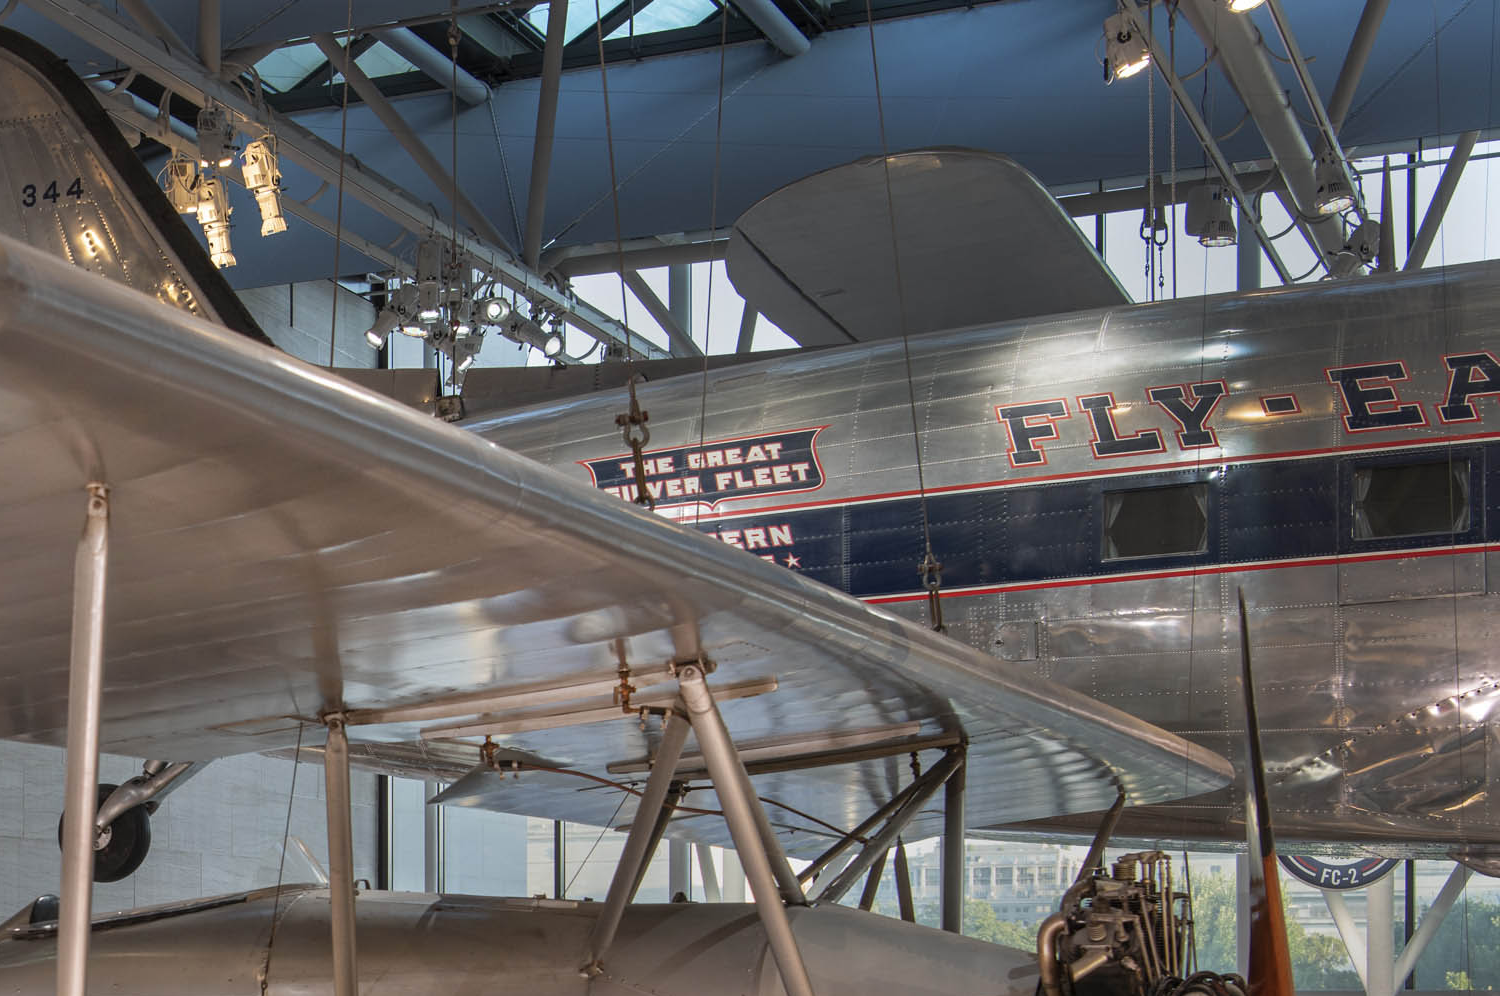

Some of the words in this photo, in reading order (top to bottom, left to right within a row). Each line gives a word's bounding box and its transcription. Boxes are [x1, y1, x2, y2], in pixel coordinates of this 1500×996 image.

[22, 177, 84, 207] 344
[997, 379, 1229, 468] FLY
[620, 457, 675, 479] THE
[687, 442, 783, 469] GREAT
[715, 462, 811, 491] FLEET
[1320, 867, 1360, 886] FC-2
